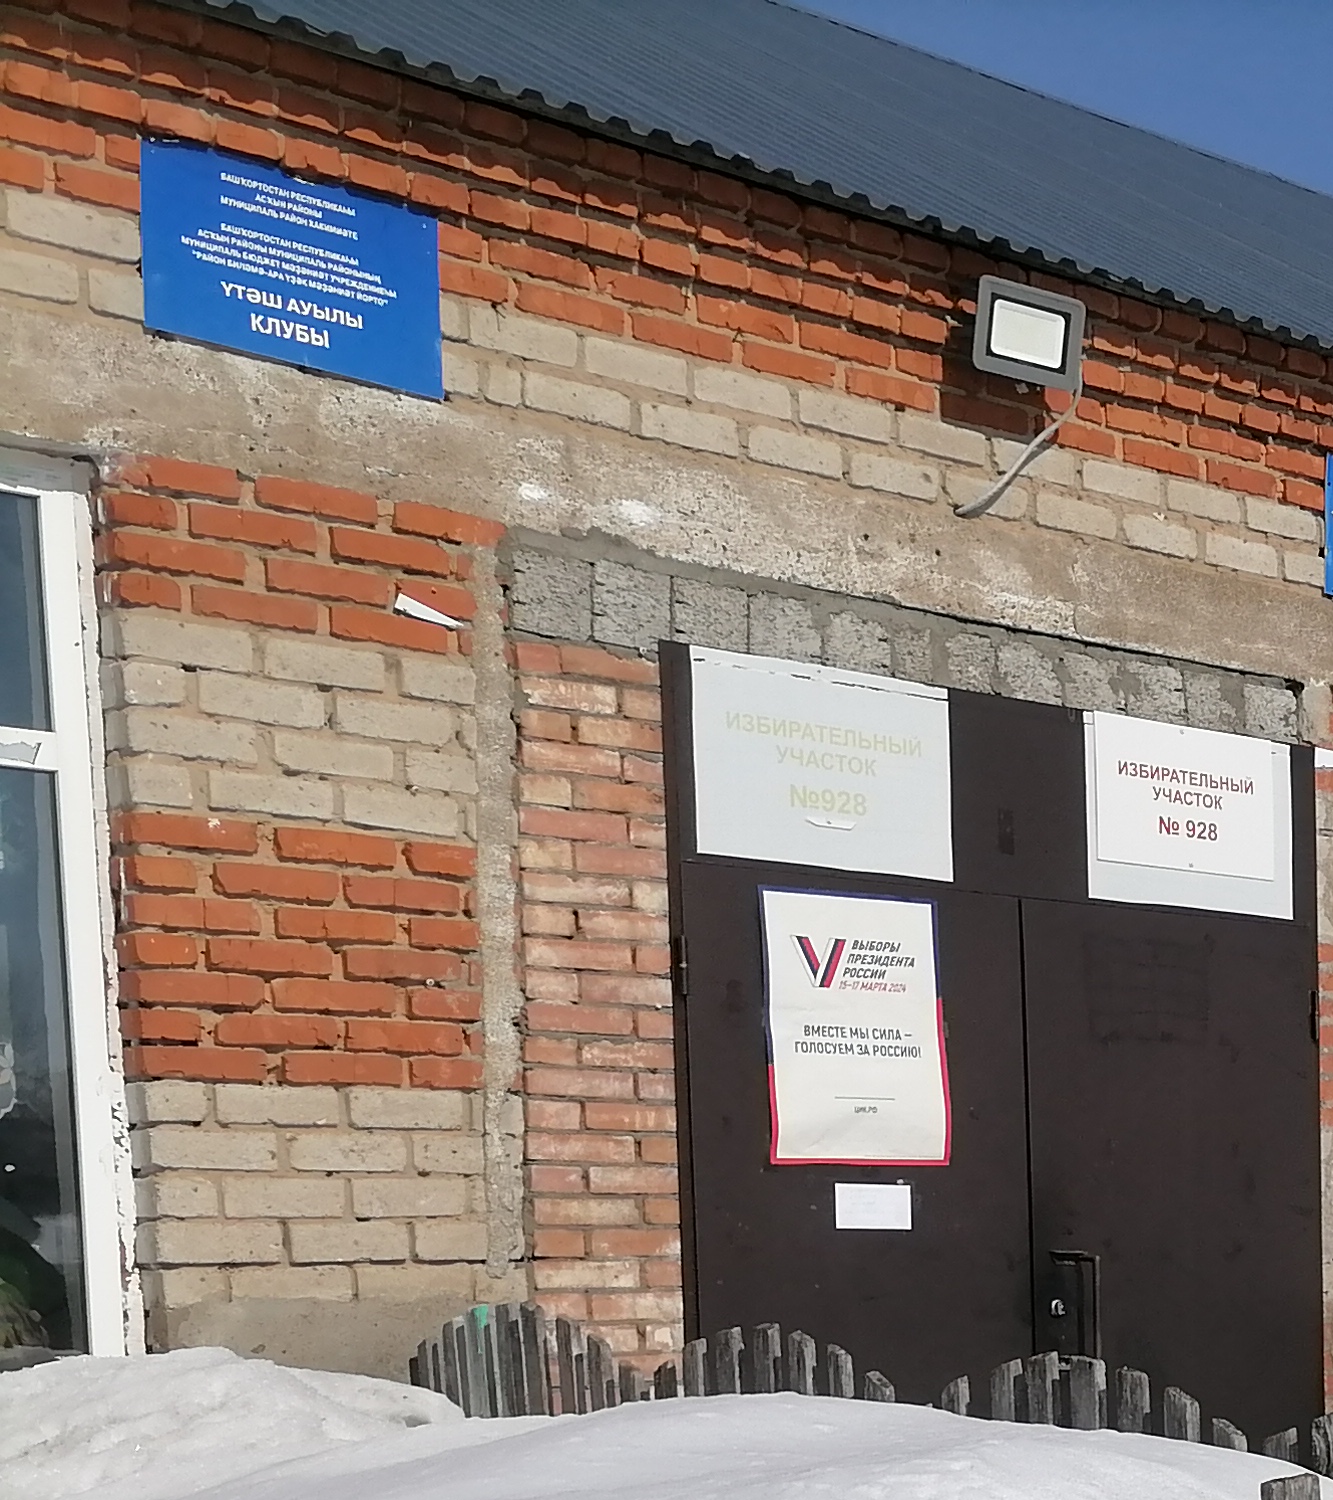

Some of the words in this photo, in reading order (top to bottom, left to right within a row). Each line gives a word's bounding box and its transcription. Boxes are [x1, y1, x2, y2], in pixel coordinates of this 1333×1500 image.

[286, 298, 364, 330] АУЫЛЫ
[250, 313, 331, 349] КЛУБЫ
[725, 710, 923, 758] ИЗБИРАТЕЛЬНЫЙ
[776, 744, 877, 777] УЧАСТОК
[1118, 759, 1254, 795] ИЗБИРАТЕЛЬНЫЙ
[789, 783, 867, 817] №928
[1152, 786, 1223, 810] УЧАСТОК
[1158, 815, 1180, 835] №
[1185, 819, 1218, 841] 928
[851, 939, 901, 953] ВЫБОРЫ
[846, 953, 915, 968] ПРЕЗИДЕНТА
[842, 967, 887, 980] РОССИИ
[860, 981, 888, 992] МАРТА
[803, 1024, 848, 1038] ВМЕСТЕ
[849, 1027, 869, 1039] МЫ
[872, 1028, 902, 1041] СИЛА
[794, 1041, 855, 1055] ГОЛОСУЕМ
[856, 1043, 870, 1056] ЗА
[872, 1045, 922, 1058] РОССИЮ!
